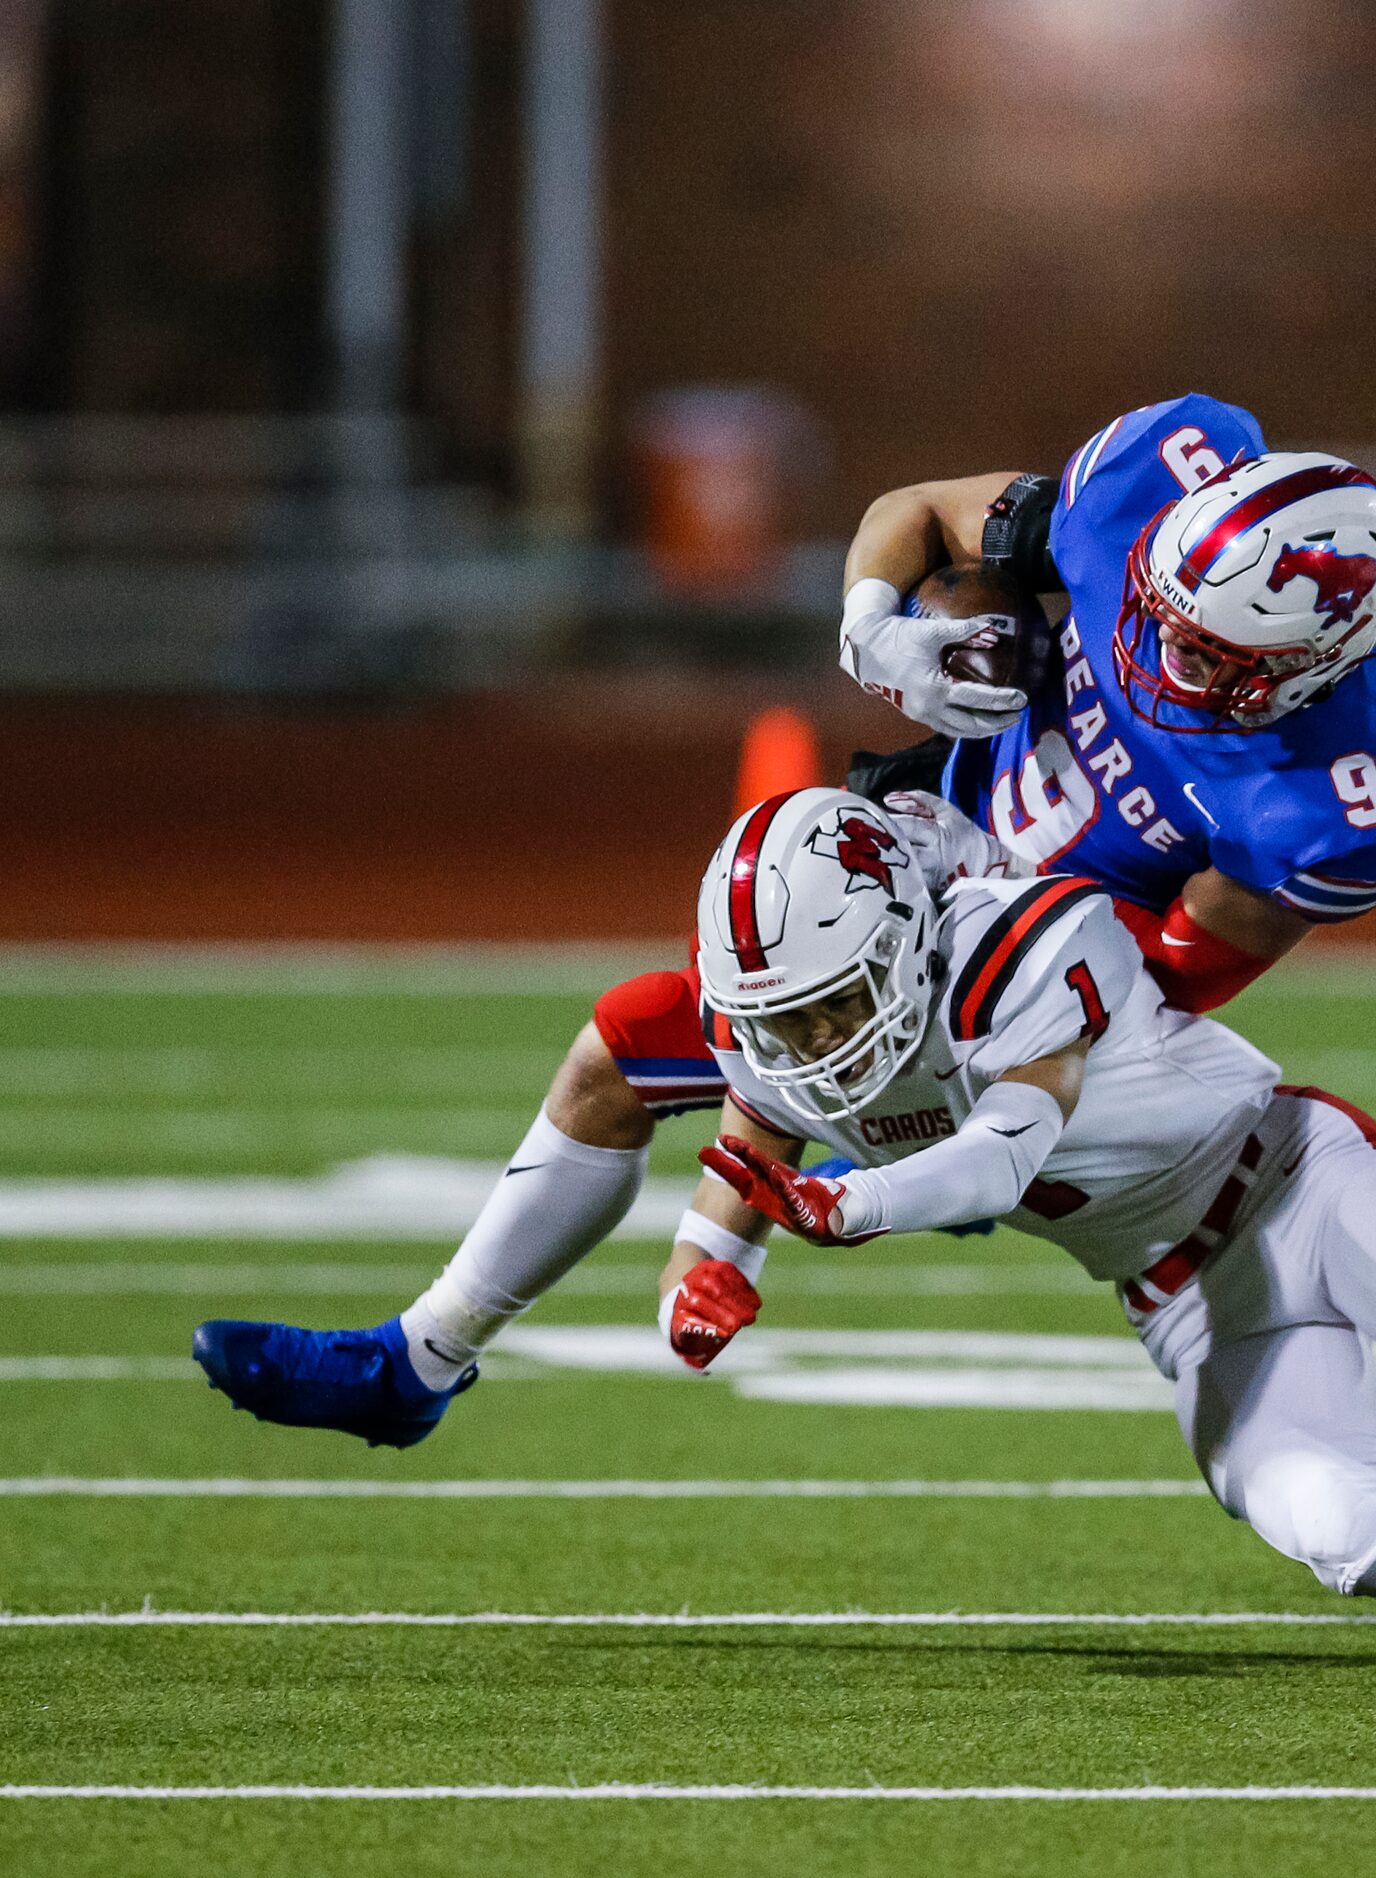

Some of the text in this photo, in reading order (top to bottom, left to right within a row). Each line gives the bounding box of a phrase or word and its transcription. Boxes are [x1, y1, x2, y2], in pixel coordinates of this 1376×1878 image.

[1162, 577, 1189, 611] WIN
[1060, 616, 1186, 854] PEARCE
[988, 727, 1101, 877] 9
[1065, 958, 1111, 1050] 1
[860, 1106, 956, 1147] CARDS
